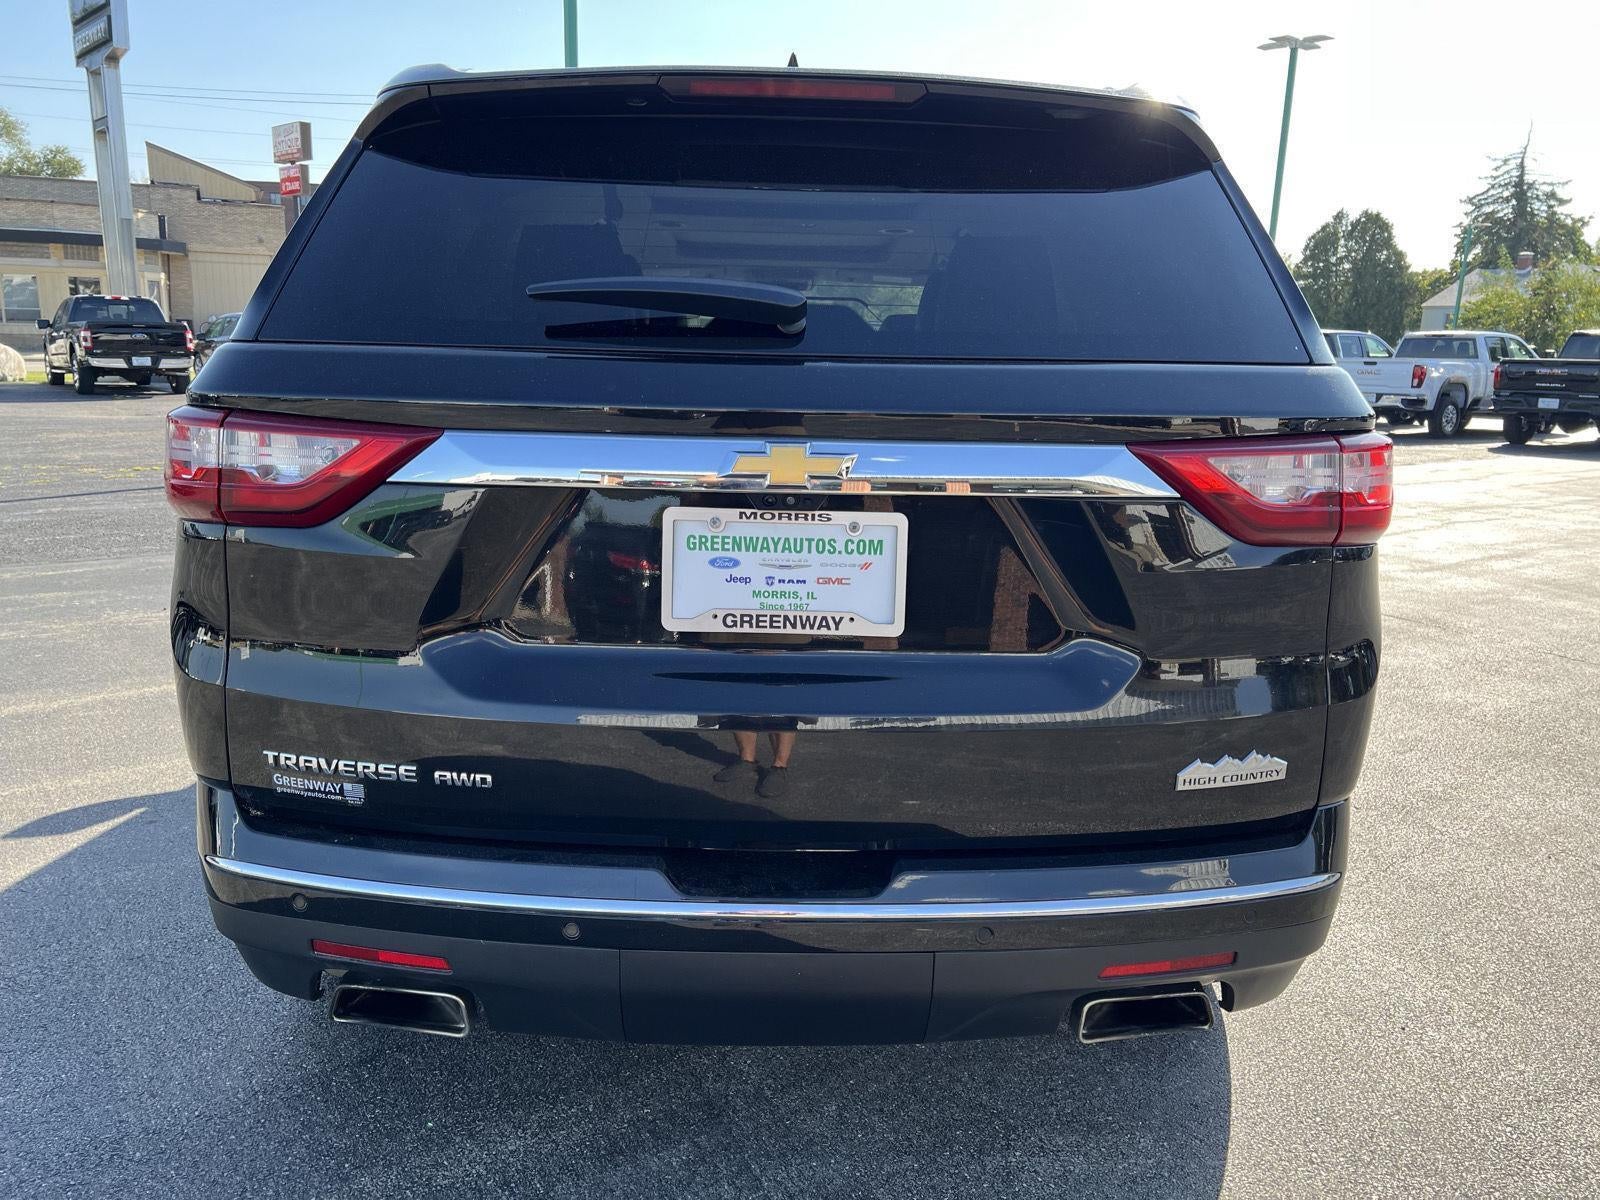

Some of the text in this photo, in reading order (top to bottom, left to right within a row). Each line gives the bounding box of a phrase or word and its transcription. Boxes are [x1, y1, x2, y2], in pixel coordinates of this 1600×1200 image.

[738, 511, 833, 523] MORRIS
[686, 534, 884, 556] GREENWAYAUTOS.COM
[714, 559, 734, 567] Ford
[725, 573, 752, 585] Jeep
[816, 577, 851, 586] GMC
[752, 590, 818, 601] MORRIS, IL
[759, 602, 810, 611] Since 1967
[722, 612, 844, 631] GREENWAY
[263, 750, 493, 788] TRAVERSE AWD
[273, 773, 341, 793] GREENWAY
[1183, 768, 1282, 786] HIGH COUNTRY
[276, 786, 342, 800] greenwayautos.com
